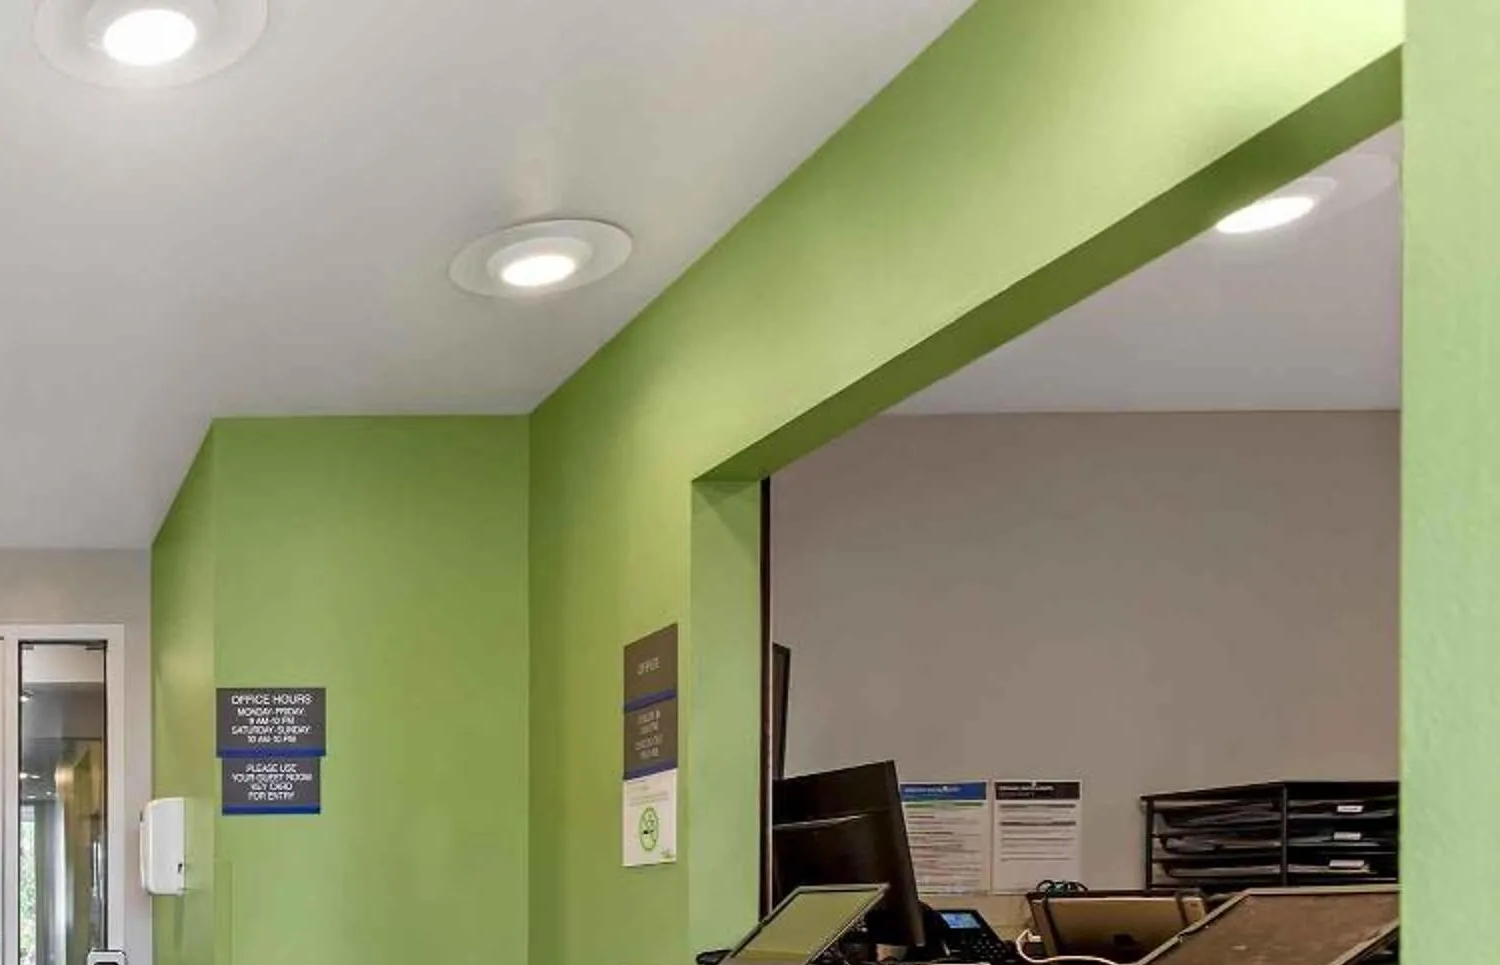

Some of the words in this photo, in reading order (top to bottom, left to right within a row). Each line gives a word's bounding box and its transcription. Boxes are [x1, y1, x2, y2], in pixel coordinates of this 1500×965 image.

[231, 694, 270, 704] OFFICE
[273, 693, 312, 704] HOURS
[245, 763, 278, 773] PLEASE
[280, 763, 297, 773] USE
[231, 773, 255, 783] YOUR
[256, 773, 284, 783] GUEST
[285, 773, 313, 782] ROOM
[250, 782, 267, 791] KEY
[269, 782, 294, 791] CARD
[248, 791, 266, 801] FOR
[267, 791, 295, 801] ENTRY
